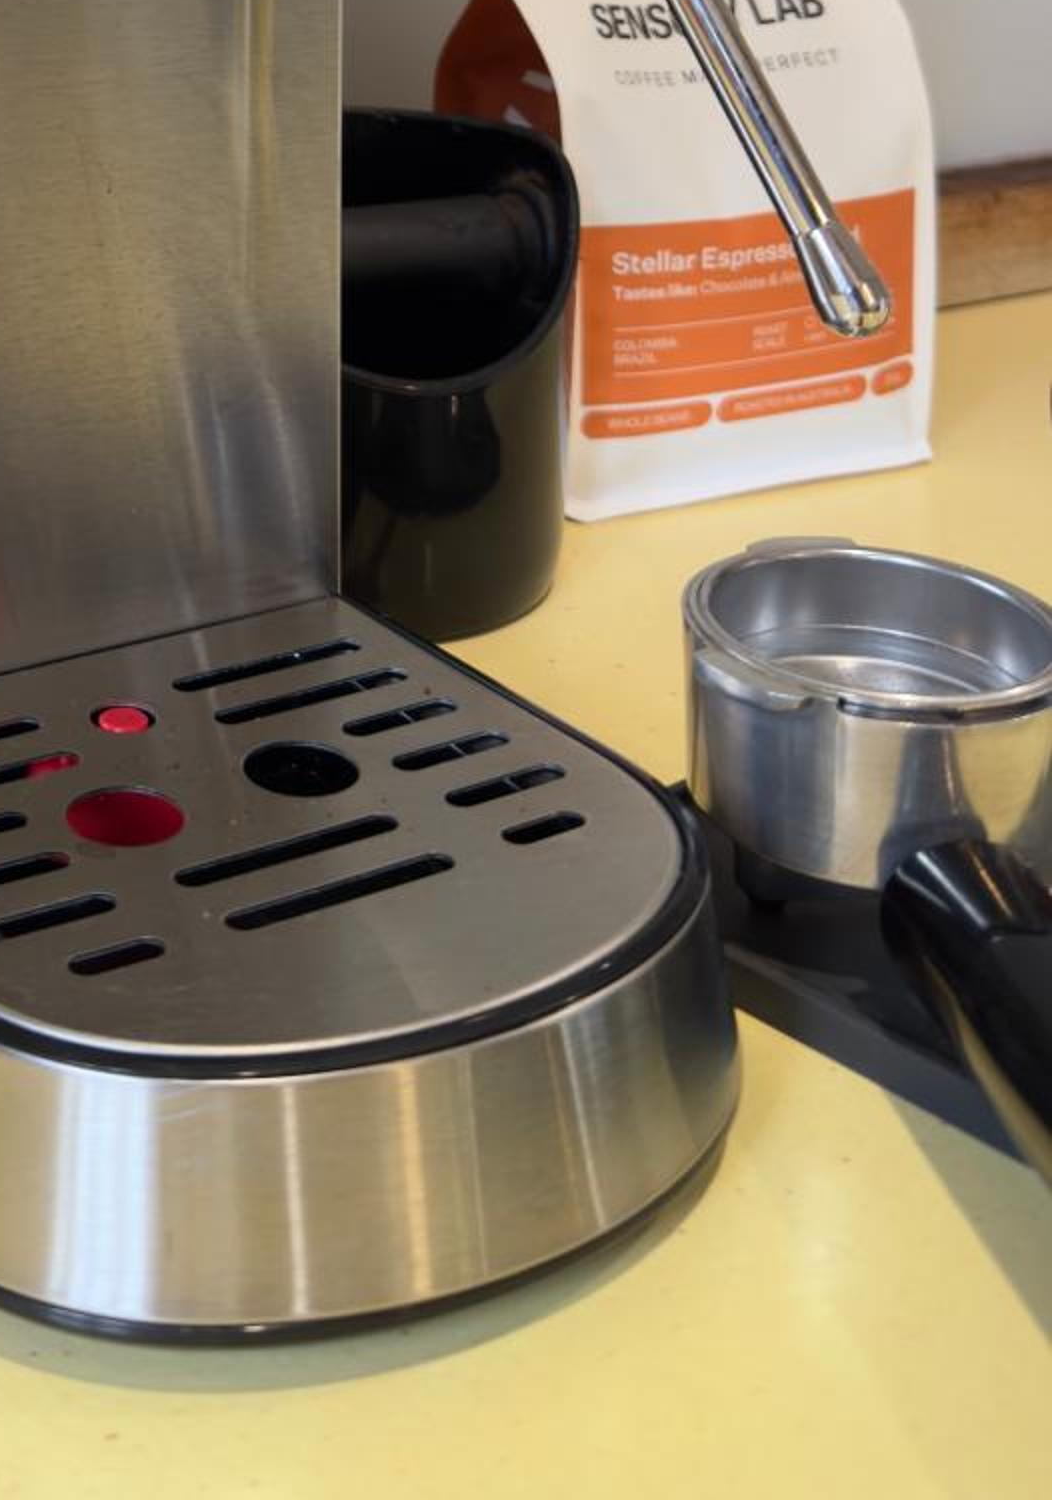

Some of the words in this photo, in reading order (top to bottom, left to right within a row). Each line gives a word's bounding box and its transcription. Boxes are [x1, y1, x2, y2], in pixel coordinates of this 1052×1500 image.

[615, 68, 677, 87] COFFEE
[763, 48, 838, 71] ERFECT
[612, 248, 695, 276] Stellar
